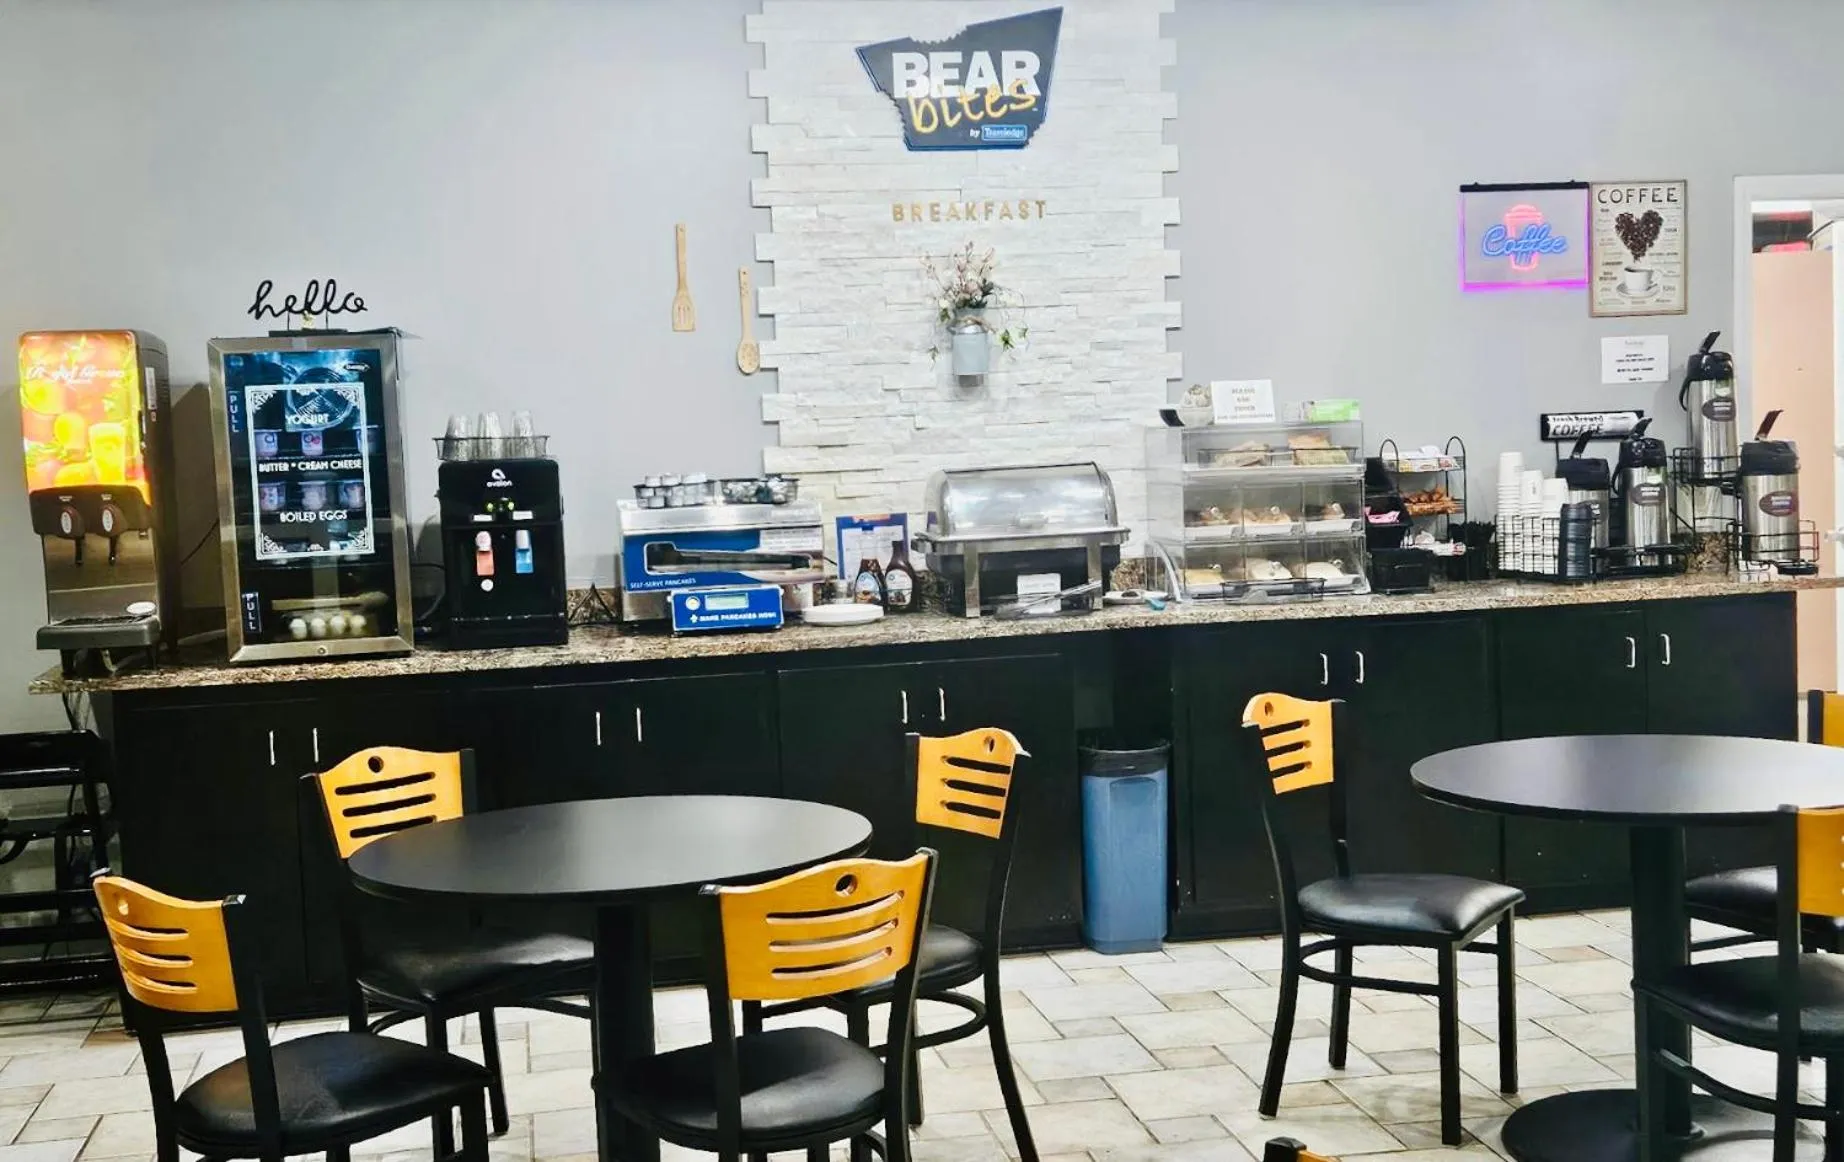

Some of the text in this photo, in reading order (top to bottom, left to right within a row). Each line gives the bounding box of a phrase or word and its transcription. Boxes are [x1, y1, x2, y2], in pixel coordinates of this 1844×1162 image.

[892, 50, 1041, 98] BEAR
[907, 79, 1036, 134] bites
[969, 128, 981, 138] by
[1597, 187, 1679, 204] COFFEE
[892, 199, 1046, 222] BREAKFAST
[1482, 222, 1570, 266] Coffee
[247, 278, 369, 320] hello
[229, 395, 239, 433] PULL
[286, 413, 330, 425] YOGURT
[258, 458, 363, 472] BUTTER CREAM CHEESE
[486, 480, 513, 488] avalon
[279, 509, 348, 522] BOILED EGGS
[630, 577, 697, 589] SELF-SERVE PANCAKES
[246, 593, 257, 631] PULL
[720, 613, 757, 621] PANCAKES
